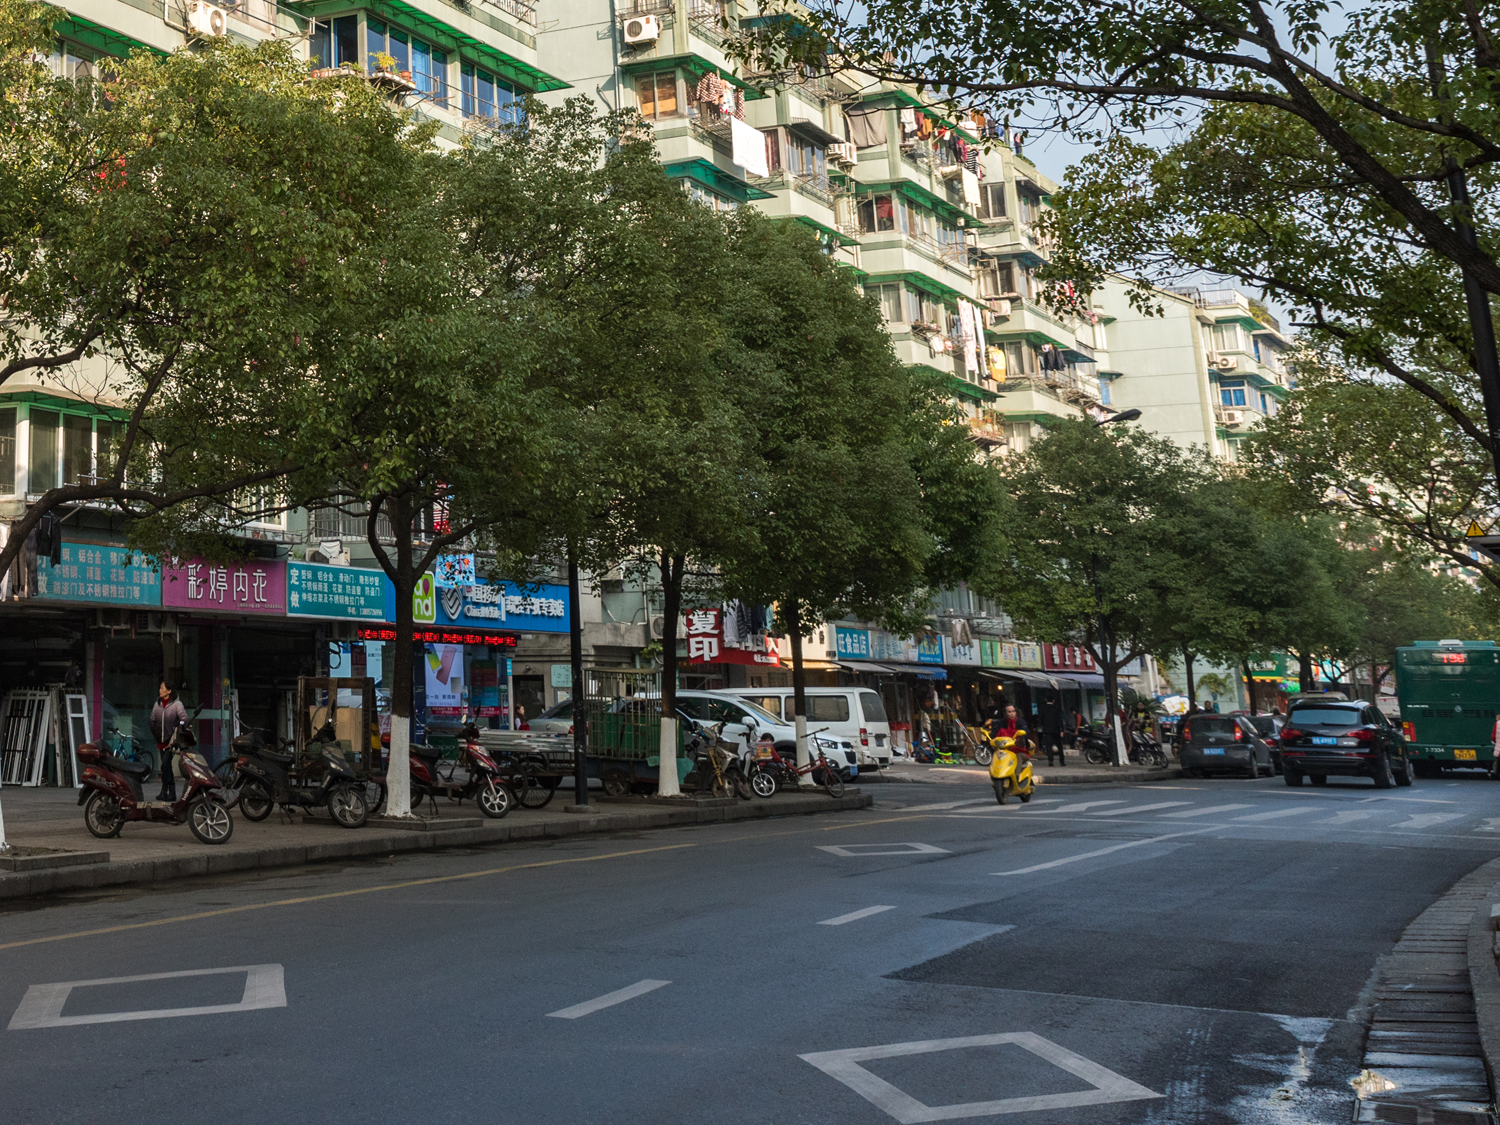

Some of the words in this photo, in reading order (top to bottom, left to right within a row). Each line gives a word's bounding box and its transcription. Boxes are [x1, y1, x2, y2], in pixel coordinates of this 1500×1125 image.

[187, 563, 268, 604] 彩婷内衣
[688, 610, 720, 662] 复印
